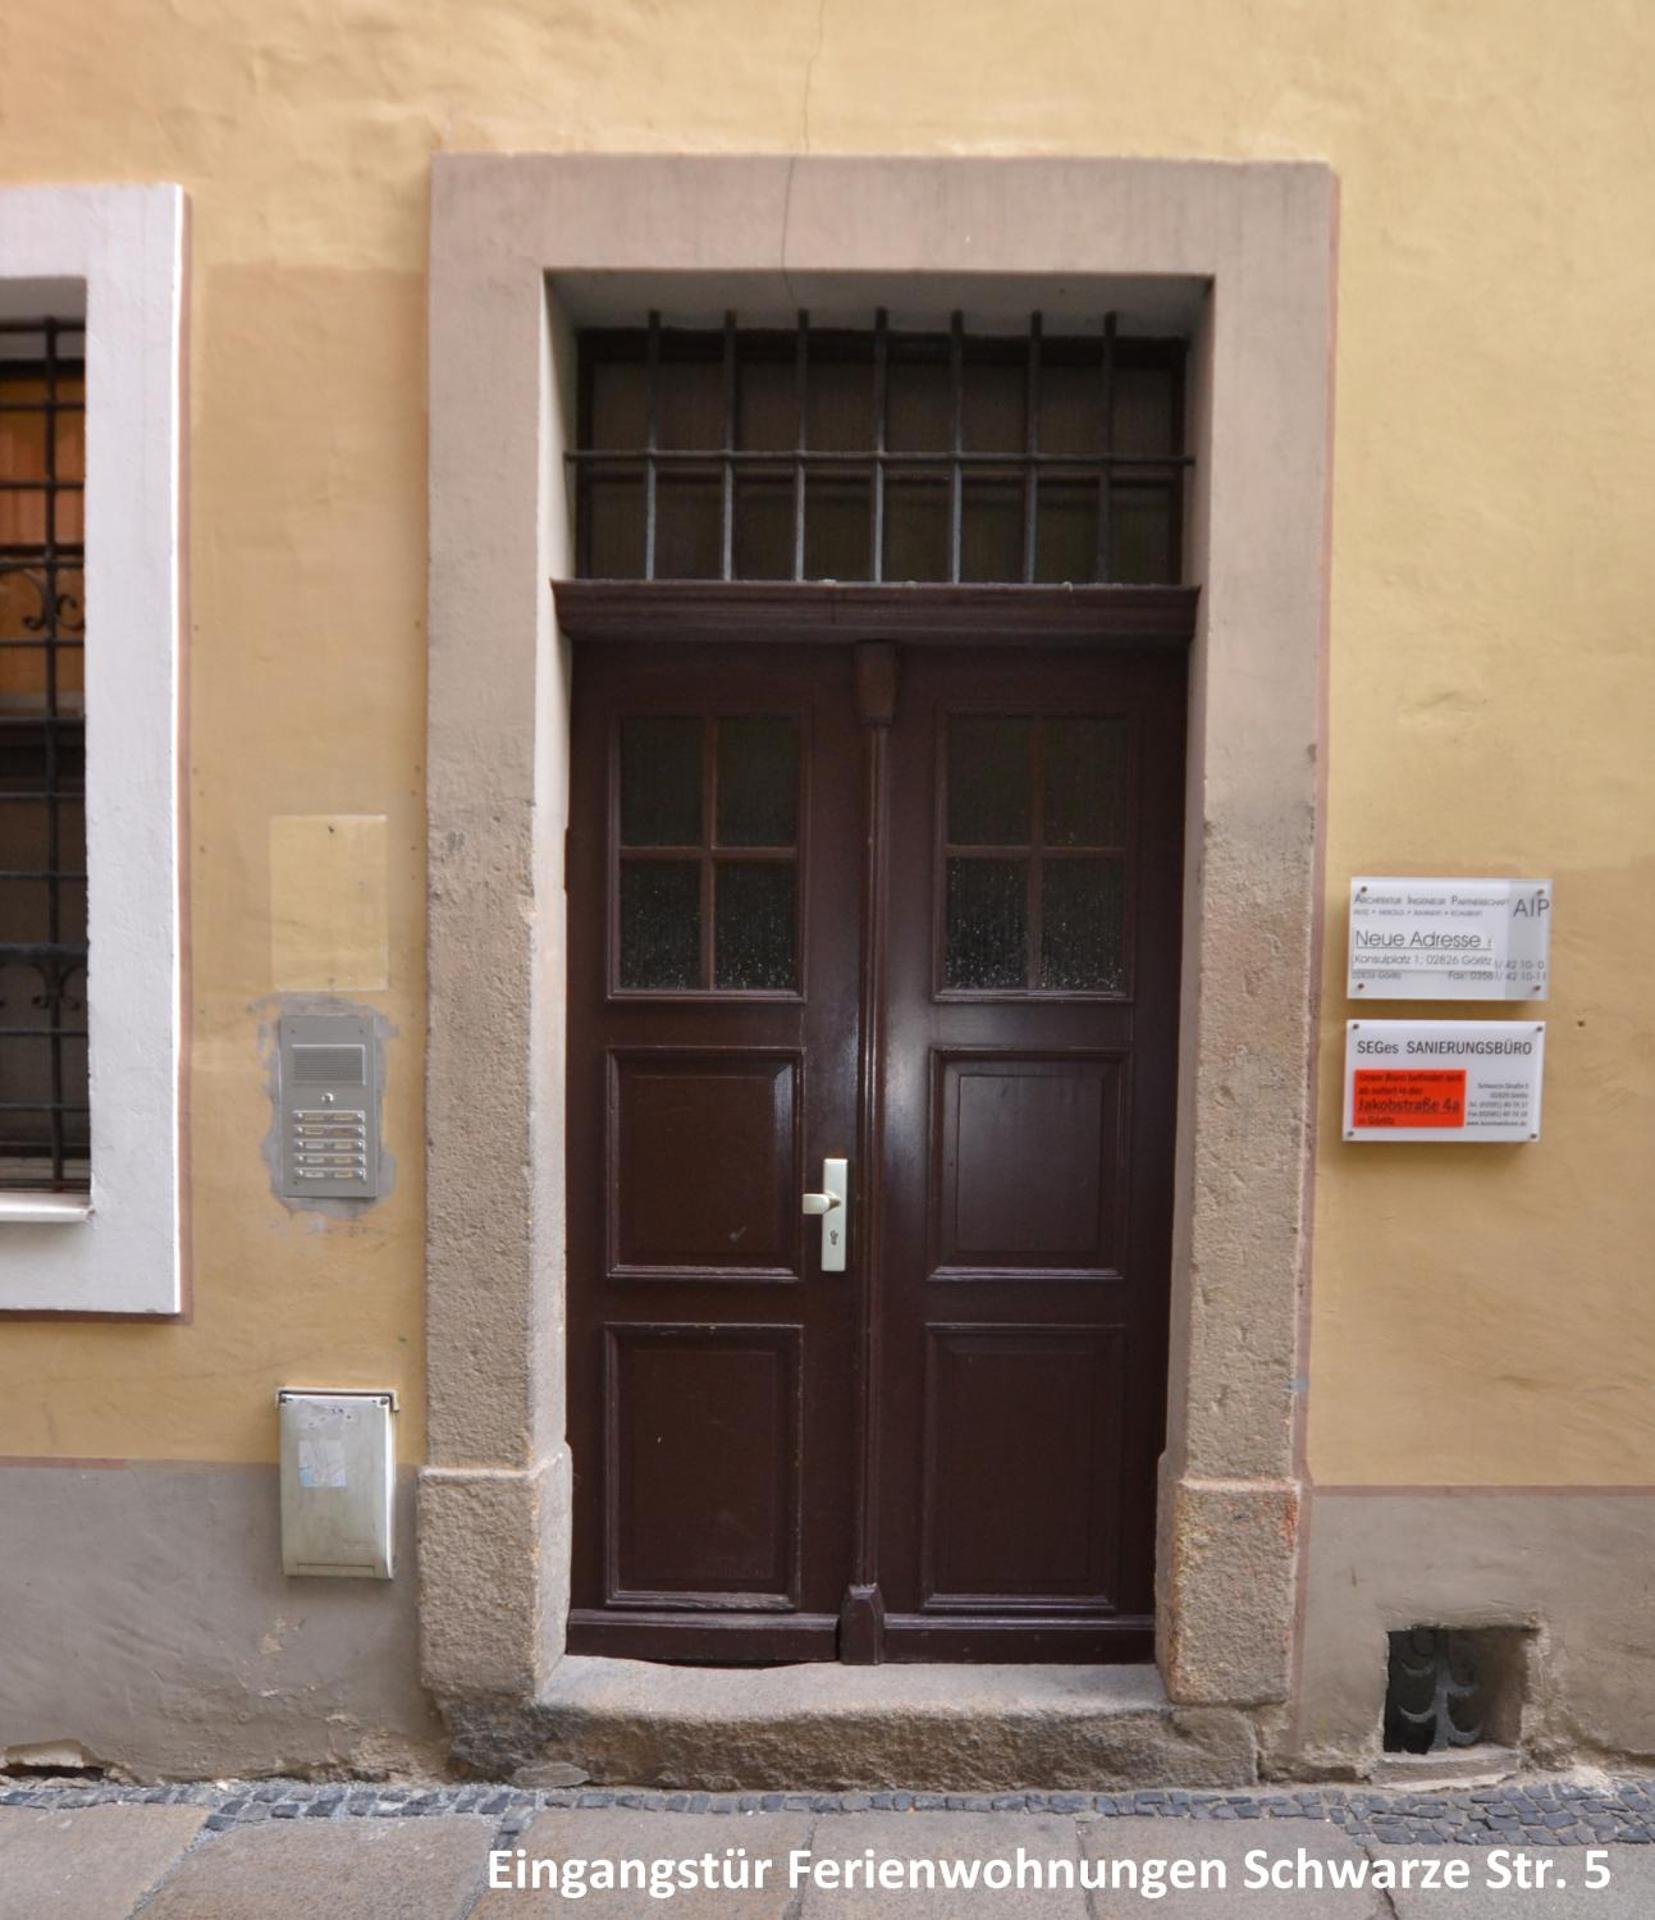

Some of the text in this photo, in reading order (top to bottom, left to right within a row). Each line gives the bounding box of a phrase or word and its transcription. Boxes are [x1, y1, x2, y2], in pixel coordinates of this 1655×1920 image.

[1513, 898, 1550, 917] AIP
[1355, 929, 1405, 948] Neue
[1409, 930, 1481, 949] Adresse
[1426, 954, 1459, 966] 02826
[1356, 1038, 1533, 1056] SEGes SANIERUNGSBÜRO
[1358, 1096, 1461, 1113] Jakobstraße 4a
